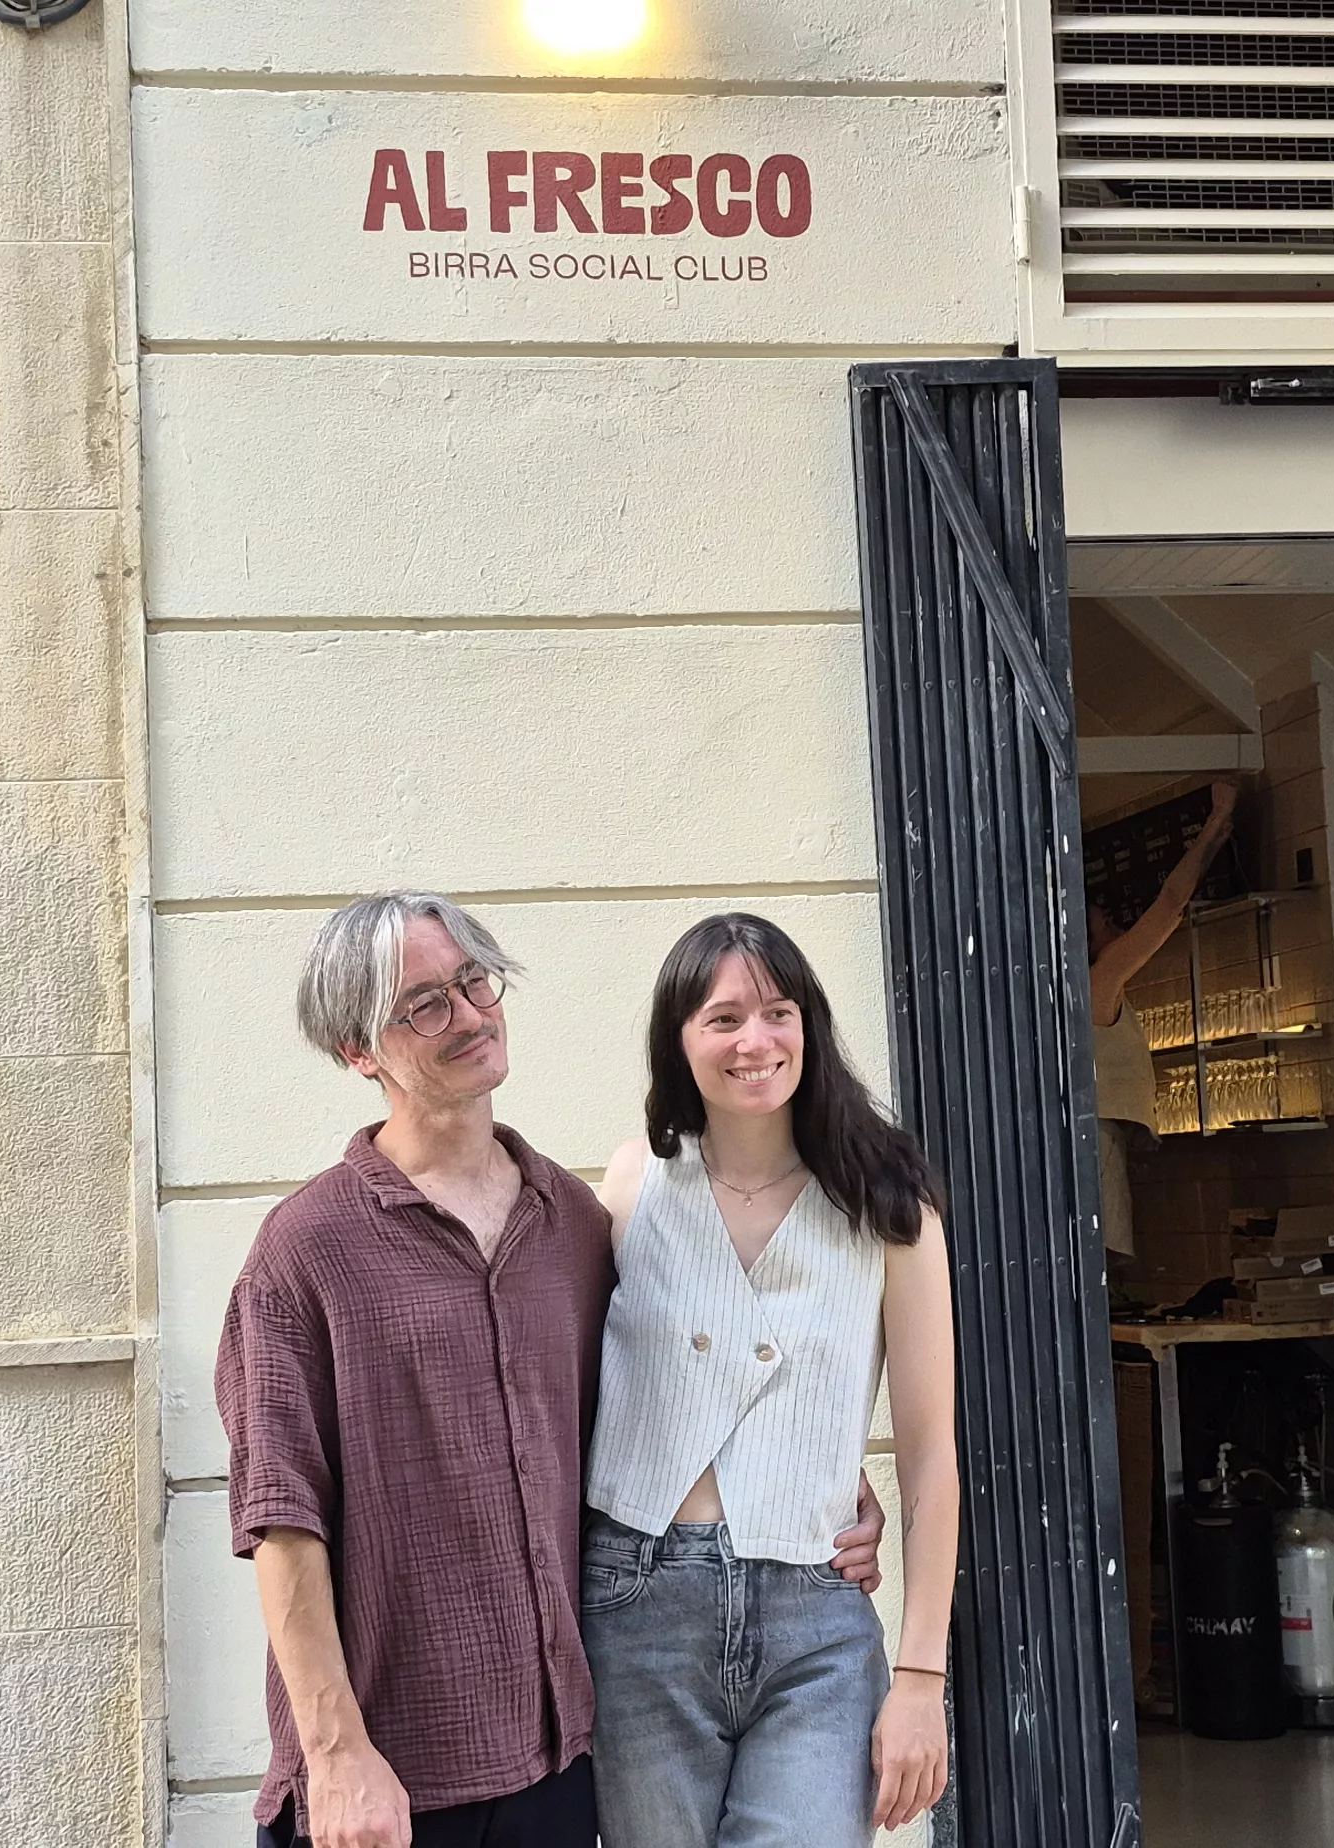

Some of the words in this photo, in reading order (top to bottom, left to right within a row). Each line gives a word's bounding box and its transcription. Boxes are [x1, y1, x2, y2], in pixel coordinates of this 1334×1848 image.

[363, 149, 467, 232] AL
[487, 150, 812, 238] FRESCO
[409, 252, 518, 280] BIRRA
[529, 253, 663, 281] SOCIAL
[674, 254, 769, 282] CLUB
[1186, 1615, 1256, 1636] CHIMAY
